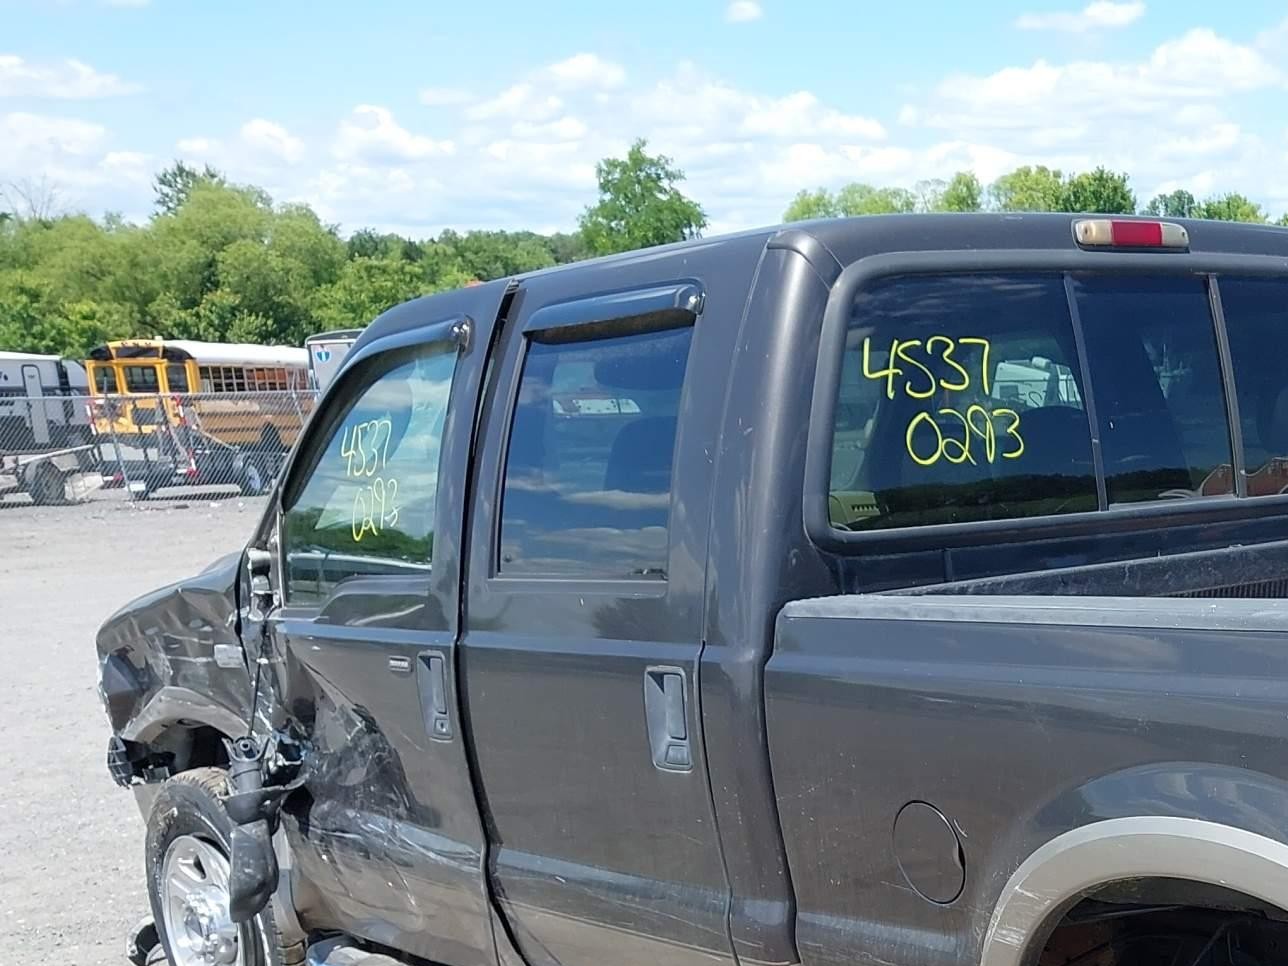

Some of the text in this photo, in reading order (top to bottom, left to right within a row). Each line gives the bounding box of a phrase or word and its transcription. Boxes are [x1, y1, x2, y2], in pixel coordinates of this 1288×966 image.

[862, 335, 991, 400] 4537
[340, 419, 393, 477] 4537
[905, 404, 1025, 466] 0293
[351, 477, 402, 542] 0293
